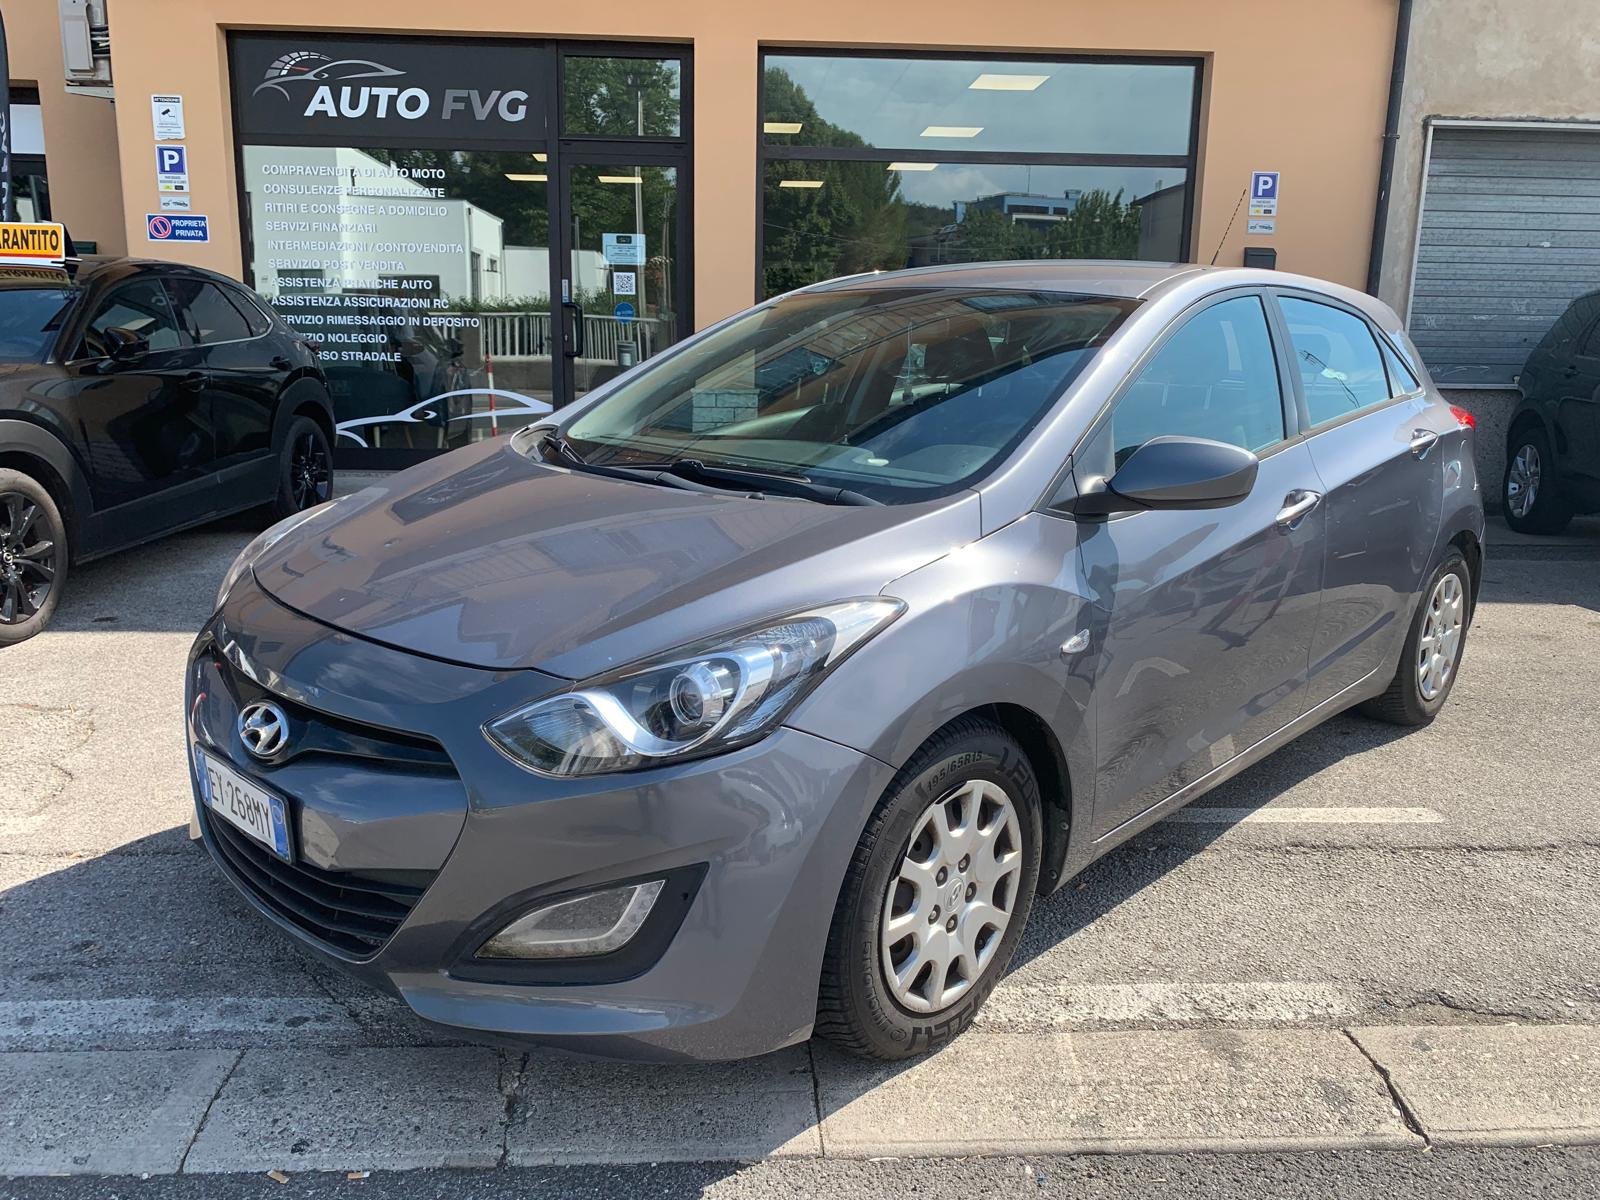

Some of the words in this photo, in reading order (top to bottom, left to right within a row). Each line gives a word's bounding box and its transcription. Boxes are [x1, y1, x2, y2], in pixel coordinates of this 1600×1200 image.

[303, 85, 430, 120] AUTO
[441, 88, 529, 122] FVG
[163, 150, 180, 171] P
[262, 165, 361, 178] COMPRAVENDITA
[364, 168, 376, 178] DI
[379, 168, 409, 178] AUTO
[412, 168, 446, 179] MOTO
[263, 184, 343, 195] CONSULENZE
[1257, 176, 1273, 197] P
[265, 202, 298, 213] RITIRI
[301, 204, 309, 213] E
[311, 204, 375, 215] CONSEGNE
[378, 205, 386, 215] A
[388, 206, 448, 216] DOMICILIO
[175, 229, 204, 237] PRIVATA
[265, 221, 310, 232] SERVIZI
[313, 222, 377, 233] FINANZIARI
[0, 228, 59, 251] RANTITO
[268, 240, 368, 252] INTERMEDIAZIONI
[376, 243, 464, 254] CONTOVENDITA
[268, 258, 321, 269] SERVIZIO
[324, 260, 354, 271] POST
[358, 260, 405, 271] VENDITA
[271, 277, 340, 288] ASSISTENZA
[342, 278, 398, 289] PRATICHE
[401, 279, 433, 290] AUTO
[271, 296, 341, 307] ASSISTENZA
[343, 296, 431, 308] ASSICURAZIONI
[433, 299, 450, 309] RC
[326, 315, 405, 326] RIMESSAGGIO
[408, 317, 420, 326] IN
[423, 317, 480, 328] DEPOSITO
[327, 333, 388, 343] NOLEGGIO
[341, 351, 402, 362] STRADALE
[927, 751, 984, 793] 195/65R15
